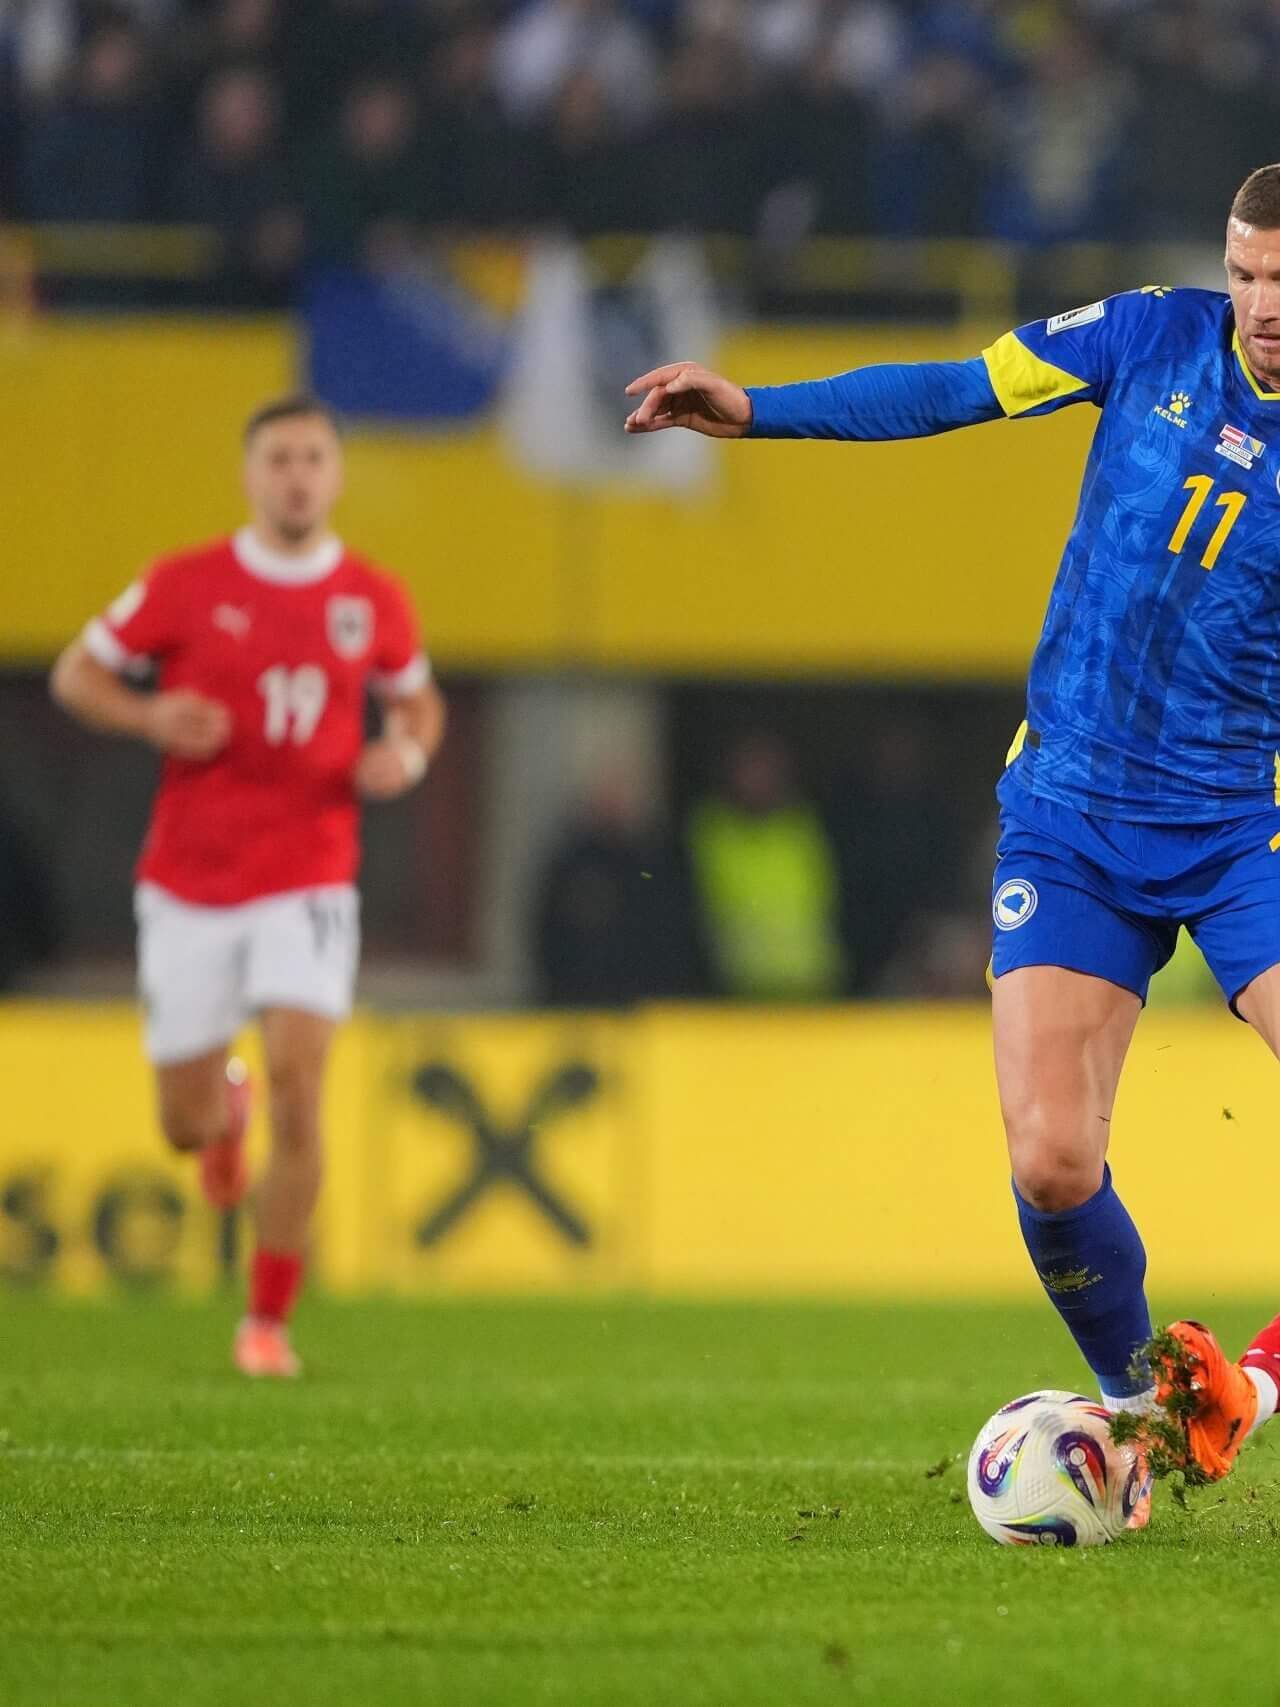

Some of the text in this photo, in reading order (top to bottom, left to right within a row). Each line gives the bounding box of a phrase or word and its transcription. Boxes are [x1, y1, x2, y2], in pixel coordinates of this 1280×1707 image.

[1153, 404, 1188, 429] KELME
[1167, 474, 1248, 571] 11
[256, 663, 328, 748] 19
